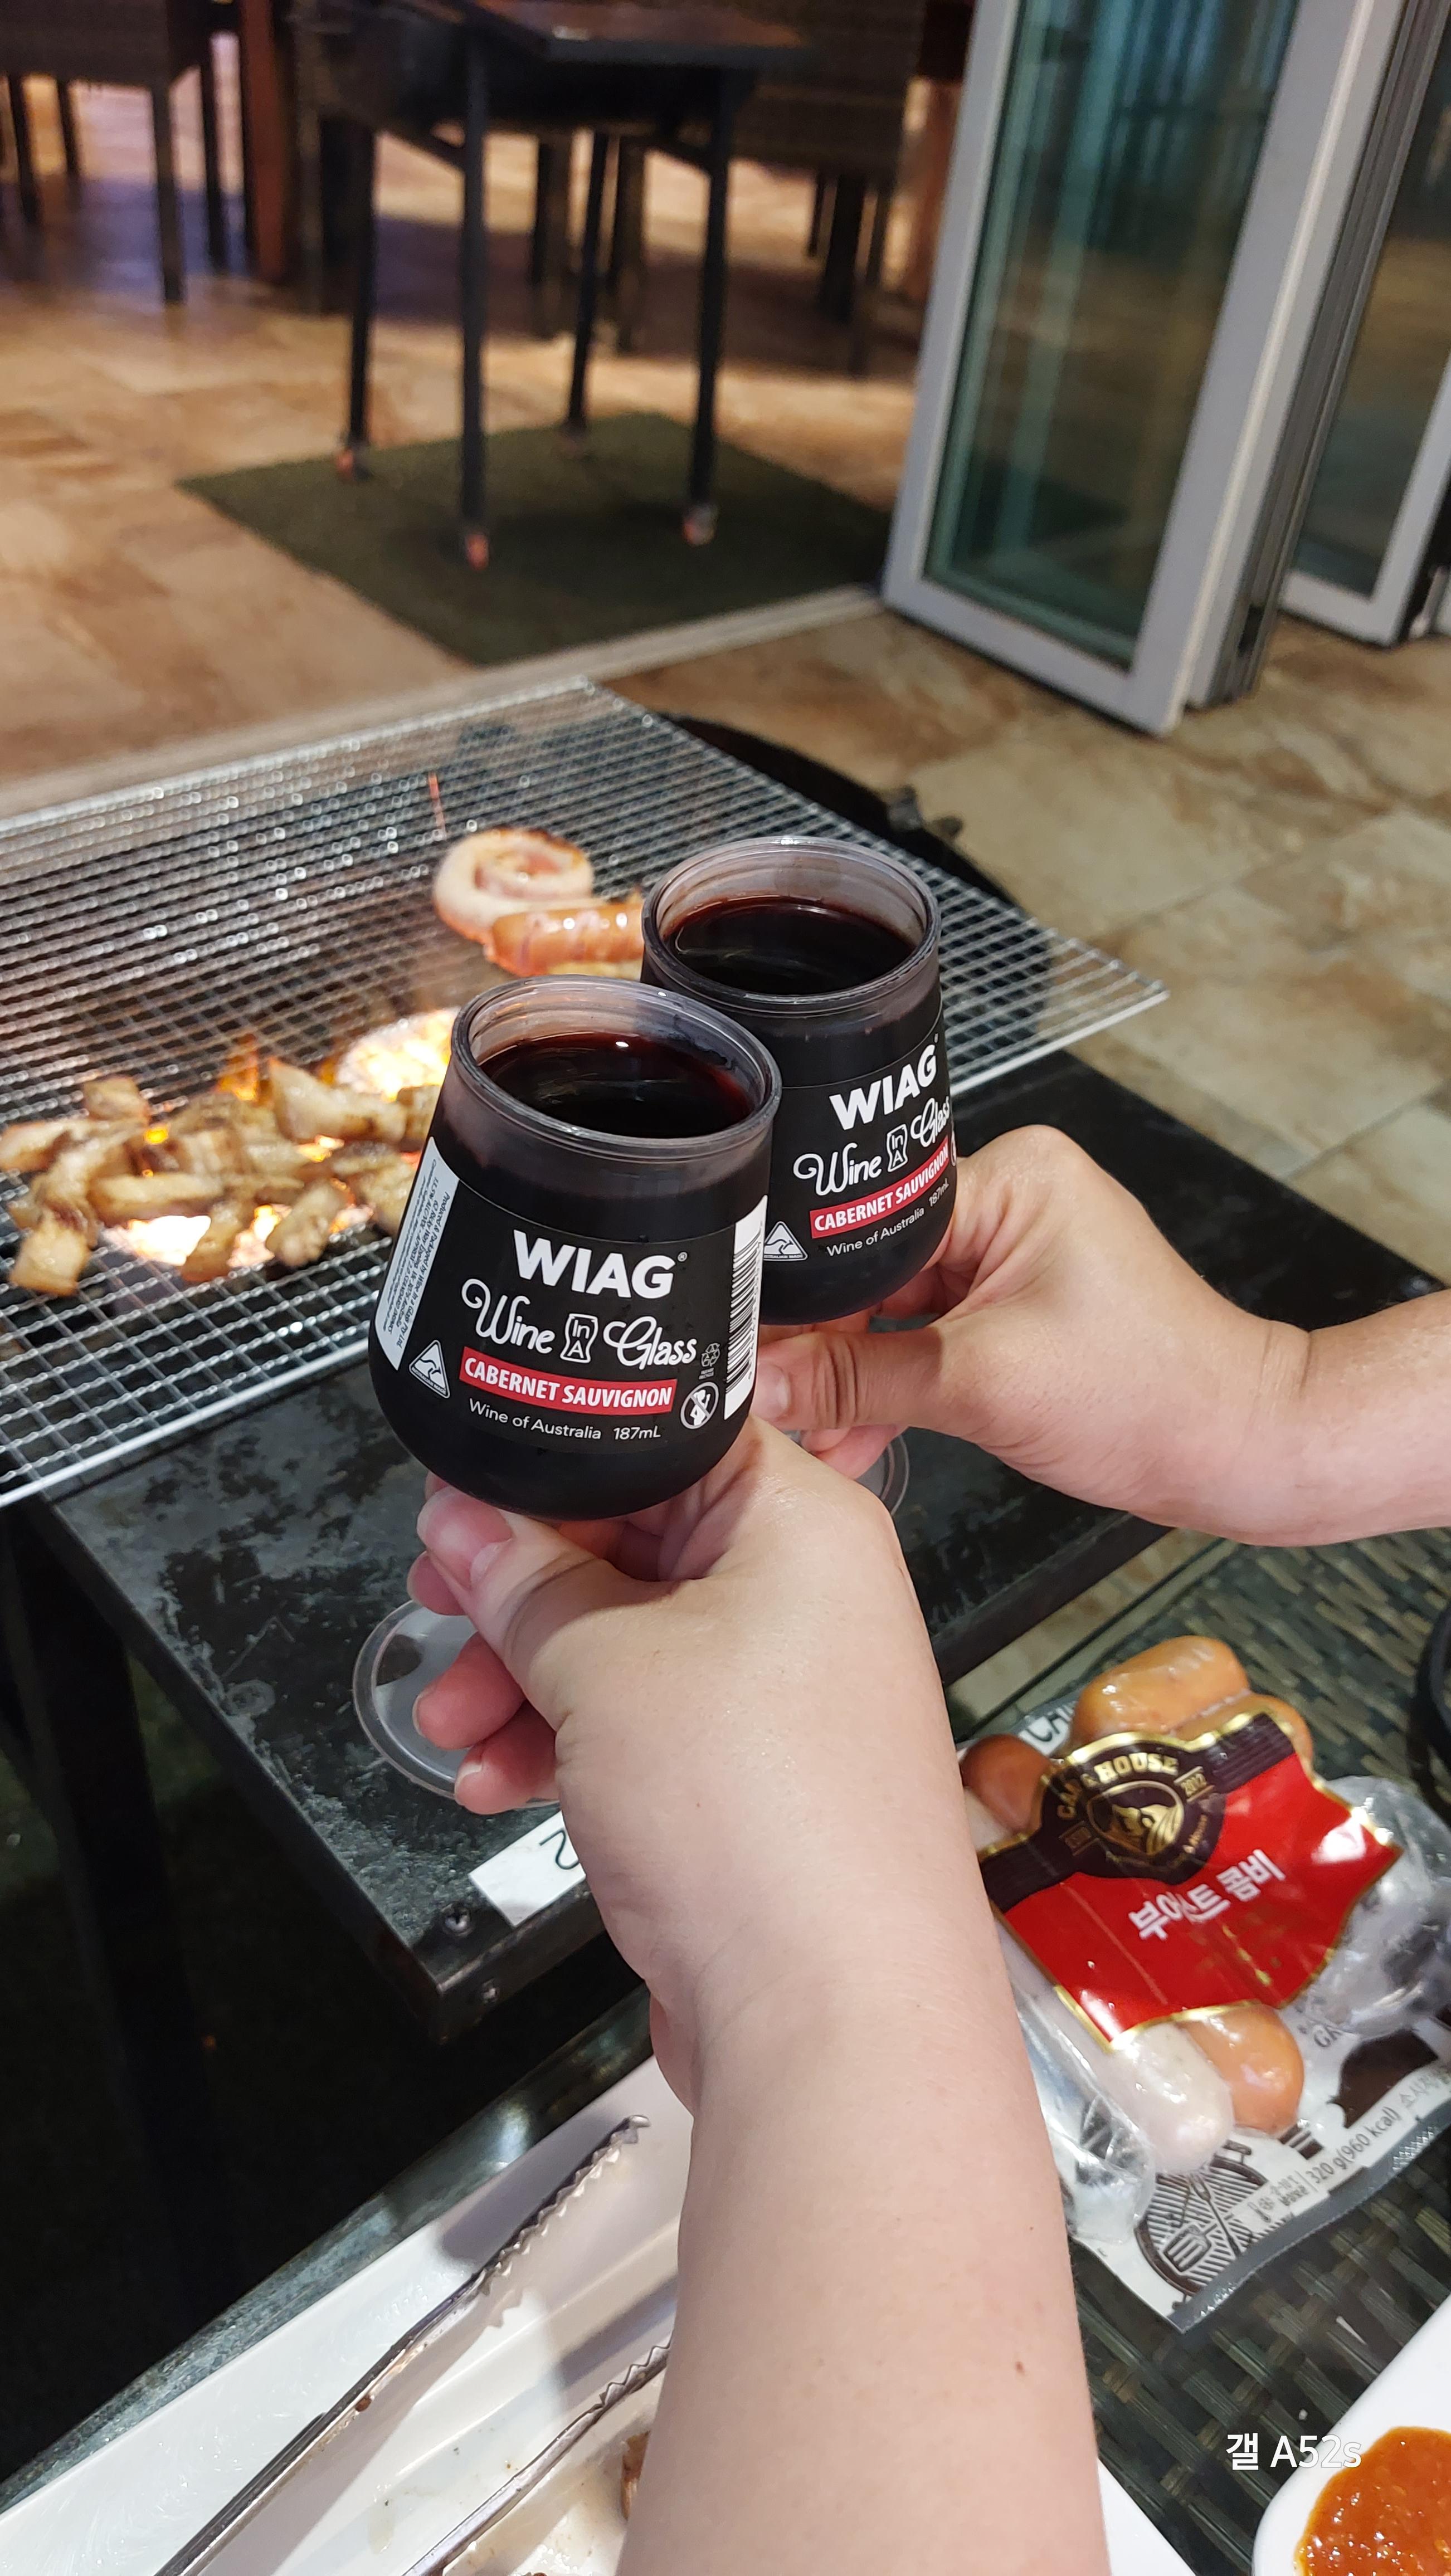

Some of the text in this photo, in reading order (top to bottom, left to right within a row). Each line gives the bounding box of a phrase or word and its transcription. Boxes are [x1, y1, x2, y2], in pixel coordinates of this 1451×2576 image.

[829, 1044, 937, 1130] WIAG
[892, 1133, 903, 1150] In
[893, 1149, 904, 1168] A
[793, 1143, 882, 1196] Wine
[814, 1141, 948, 1231] CABERNET SAUVIGNON
[826, 1238, 863, 1257] Wine
[865, 1231, 879, 1246] of
[880, 1206, 925, 1238] Australia
[514, 1229, 676, 1299] WIAG
[461, 1279, 697, 1370] Wine In A Glass
[465, 1357, 560, 1401] CABERNET
[562, 1387, 673, 1408] SAUVIGNON
[469, 1398, 661, 1440] Wine of Australia 187mL
[1094, 1752, 1179, 1784] HOUSE
[1216, 1848, 1286, 1902] 콤비
[1306, 2162, 1334, 2183] 320
